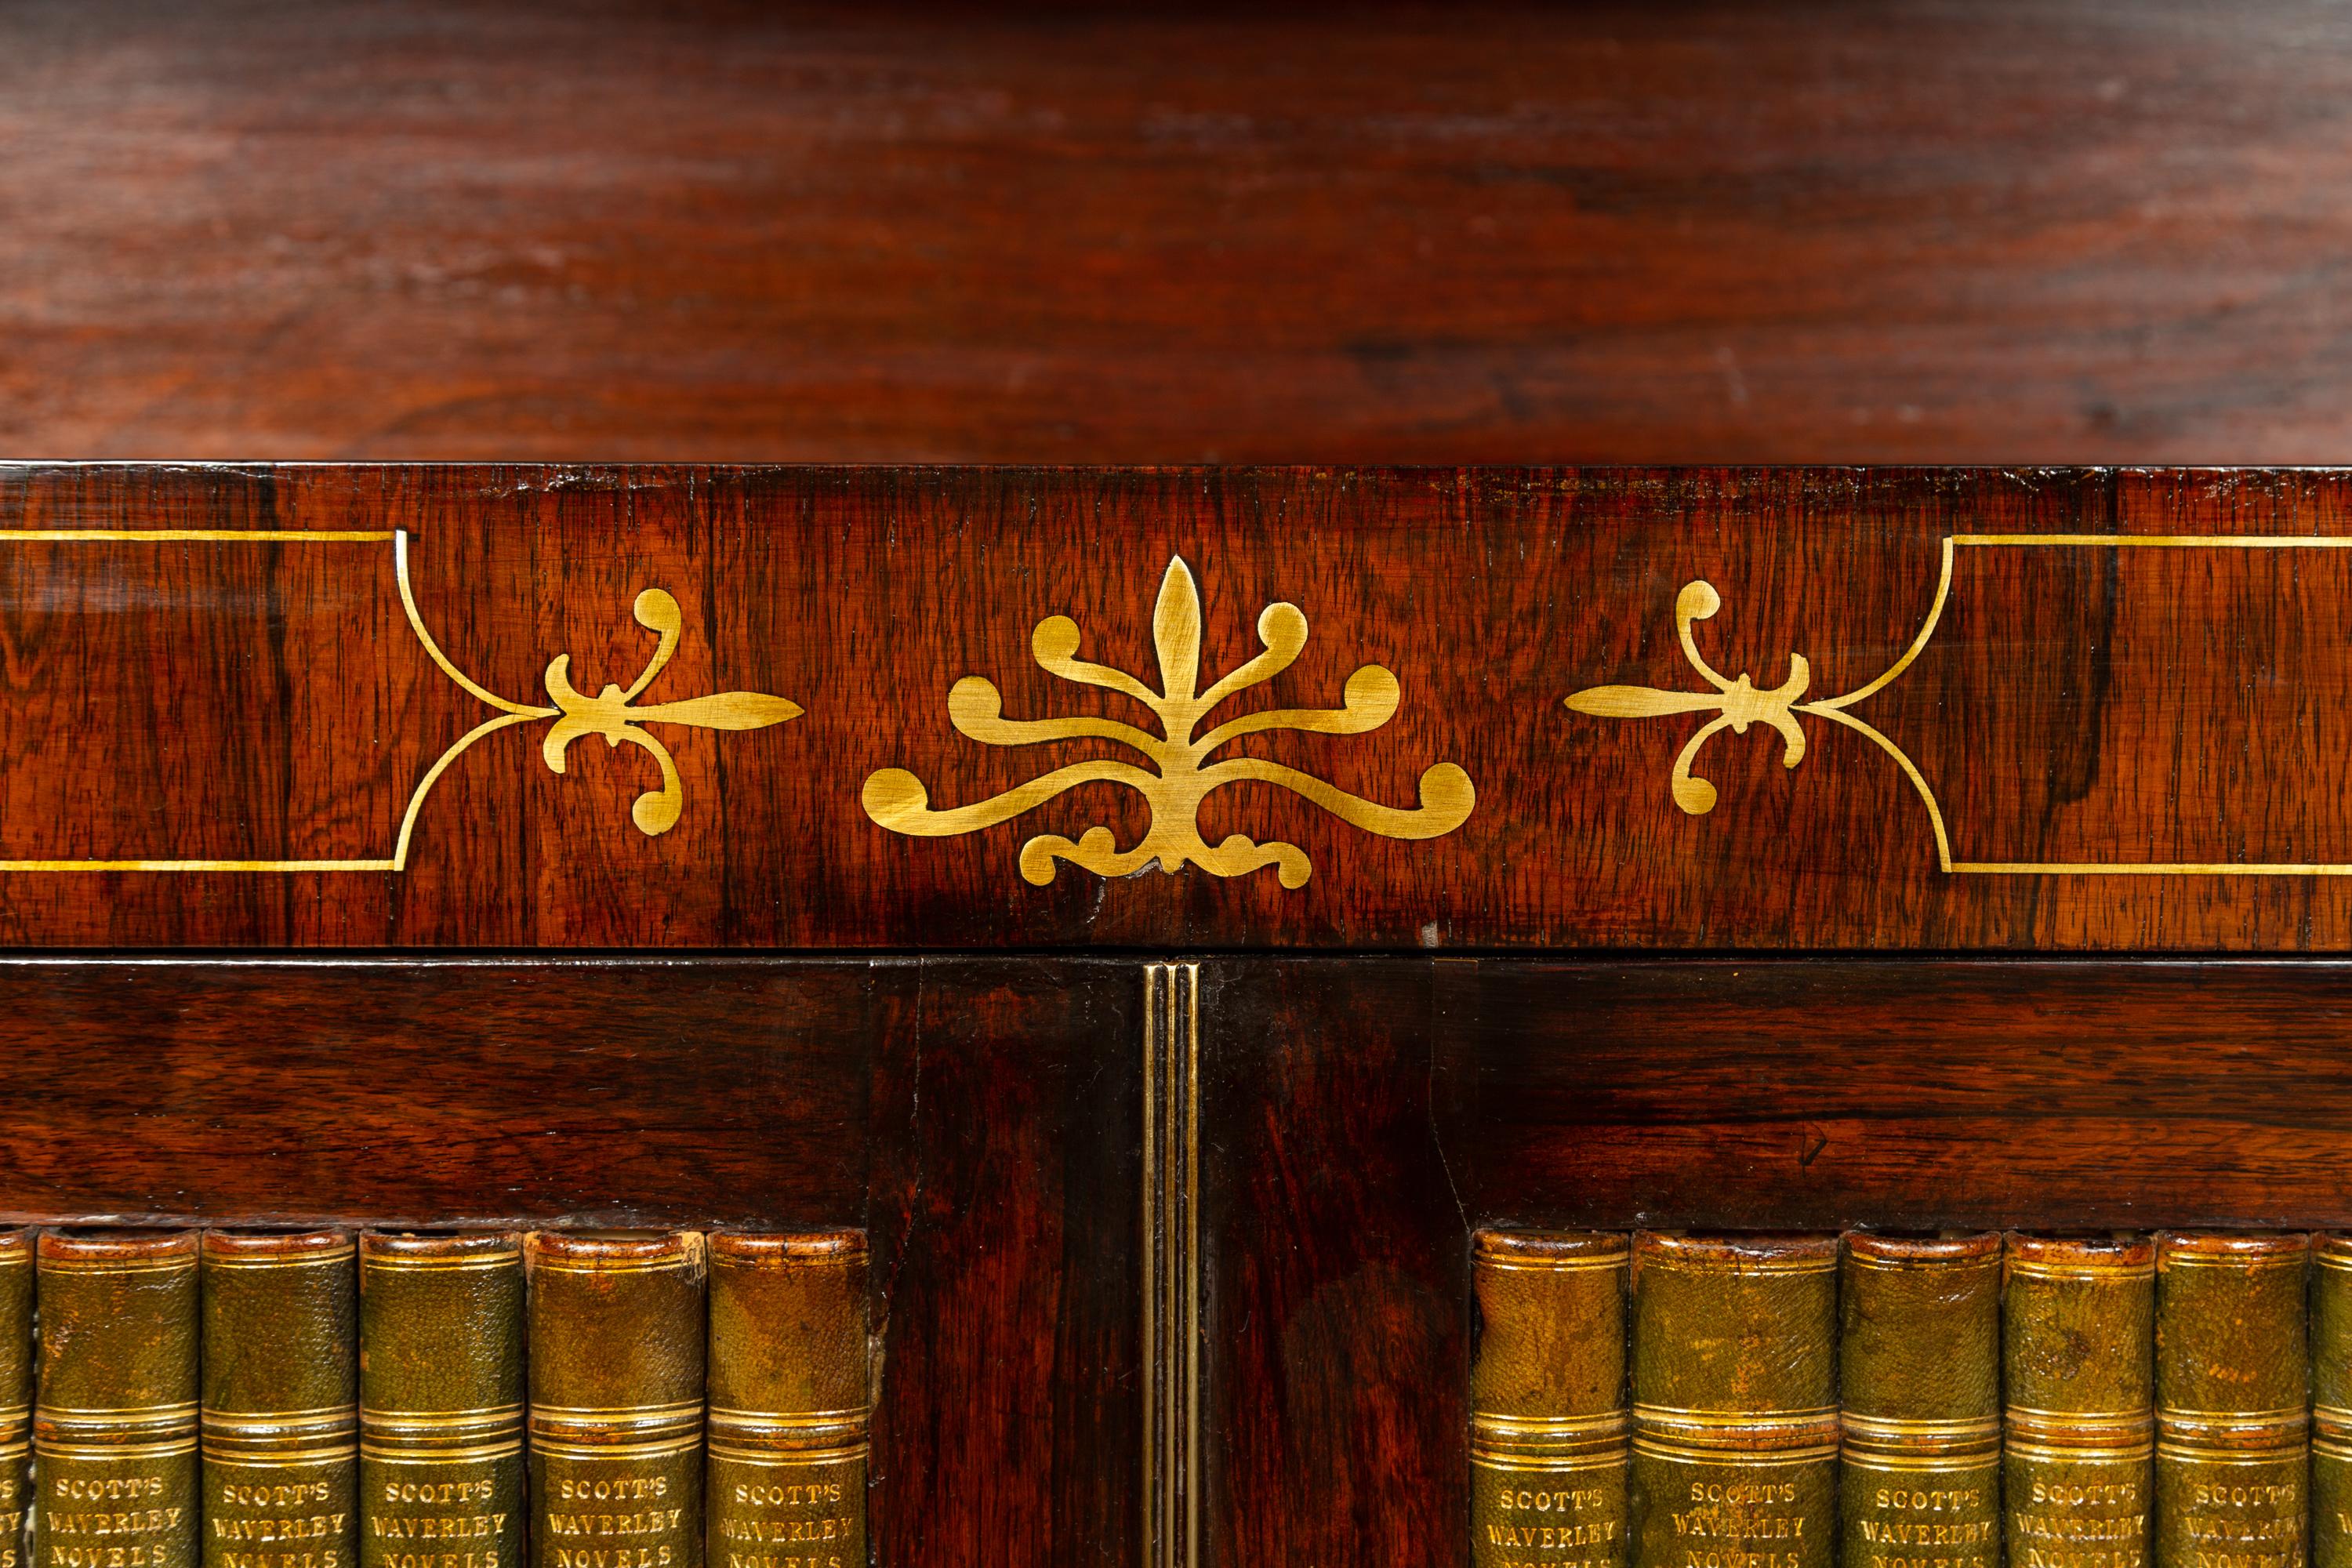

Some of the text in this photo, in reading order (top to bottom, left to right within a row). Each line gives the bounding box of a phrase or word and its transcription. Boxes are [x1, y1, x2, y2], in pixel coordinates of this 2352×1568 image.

[56, 1477, 162, 1499] SCOTT'S
[223, 1483, 329, 1506] SCOTT'S
[385, 1480, 493, 1503] SCOTT'S
[561, 1476, 666, 1499] SCOTT'S
[736, 1483, 840, 1504] SCOTT'S
[1691, 1483, 1795, 1504] SCOTT'S
[2033, 1483, 2136, 1504] SCOTT'S
[2196, 1484, 2296, 1504] SCOTT'S
[1501, 1489, 1602, 1512] SCOTT'S
[1877, 1489, 1980, 1510] SCOTT'S
[47, 1508, 182, 1534] WAVERLEY
[213, 1514, 345, 1541] WAVERLEY
[372, 1514, 506, 1538] WAVERLEY
[549, 1508, 681, 1535] WAVERLEY
[721, 1517, 851, 1542] WAVERLEY
[1673, 1514, 1805, 1538] WAVERLEY
[1860, 1520, 1991, 1544] WAVERLEY
[2016, 1513, 2144, 1539] WAVERLEY
[1487, 1521, 1614, 1548] WAVERLEY
[51, 1544, 166, 1568] NOVELS
[223, 1551, 337, 1568] NOVELS
[383, 1551, 499, 1568] NOVELS
[557, 1544, 671, 1568] NOVELS
[1687, 1551, 1798, 1568] NOVELS
[2029, 1548, 2140, 1568] NOVELS
[2197, 1551, 2302, 1568] NOVELS
